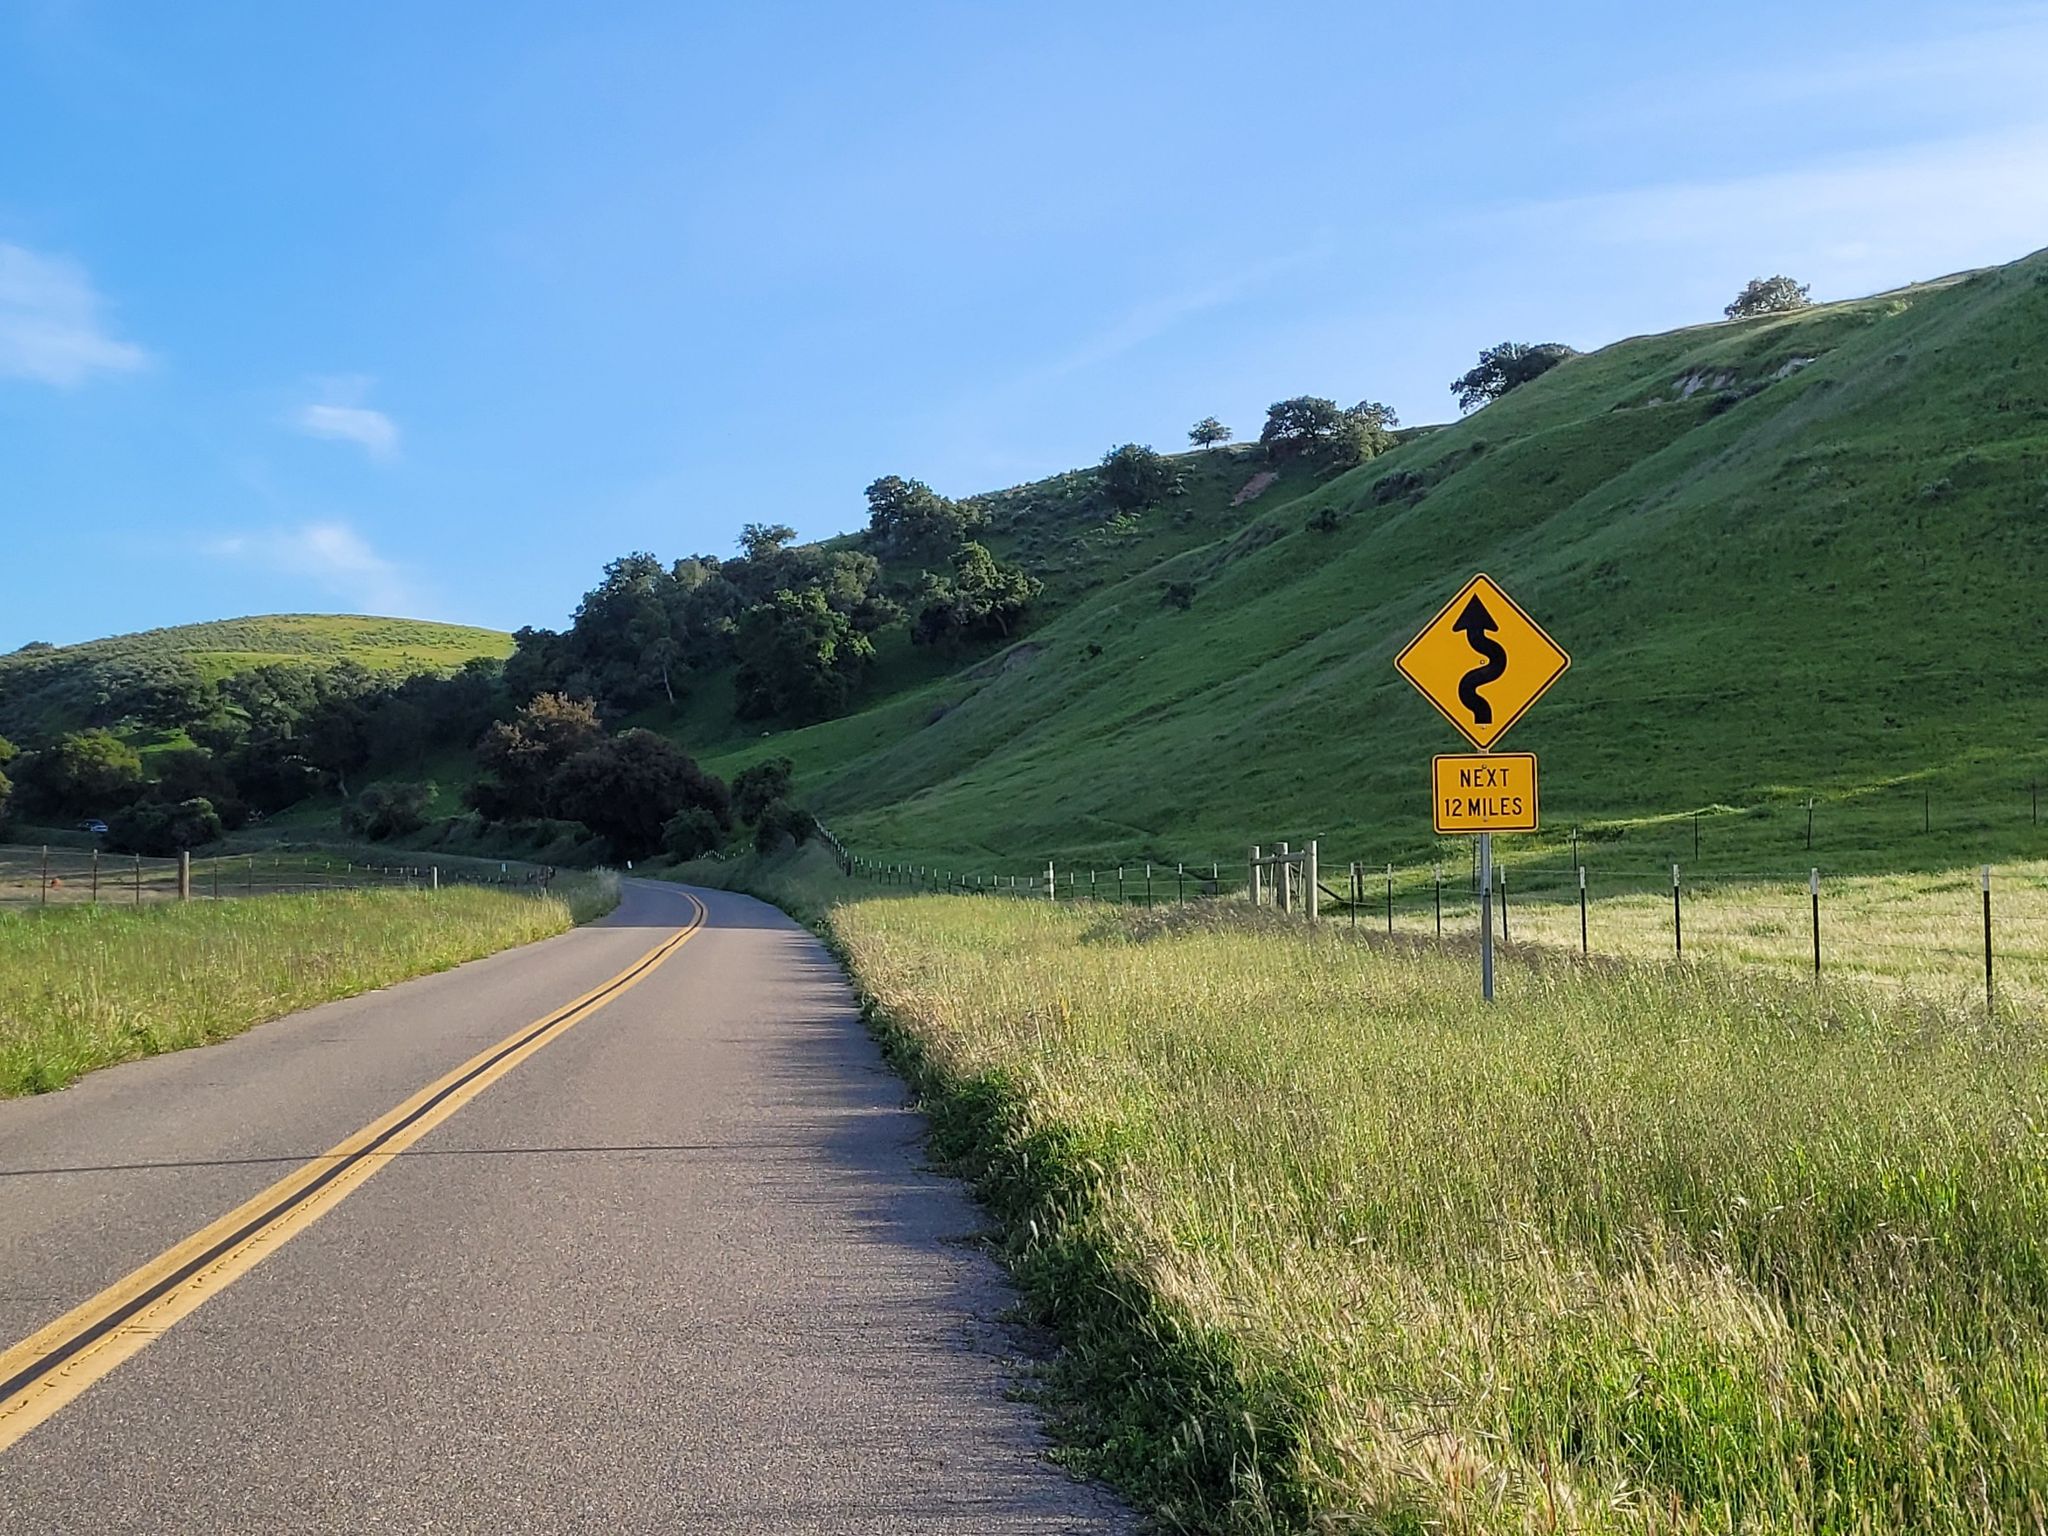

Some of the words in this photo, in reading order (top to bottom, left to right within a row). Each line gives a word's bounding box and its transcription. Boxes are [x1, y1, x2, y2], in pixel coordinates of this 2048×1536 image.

[1460, 768, 1509, 788] NEXT
[1445, 798, 1463, 817] 12
[1468, 797, 1522, 817] MILES
